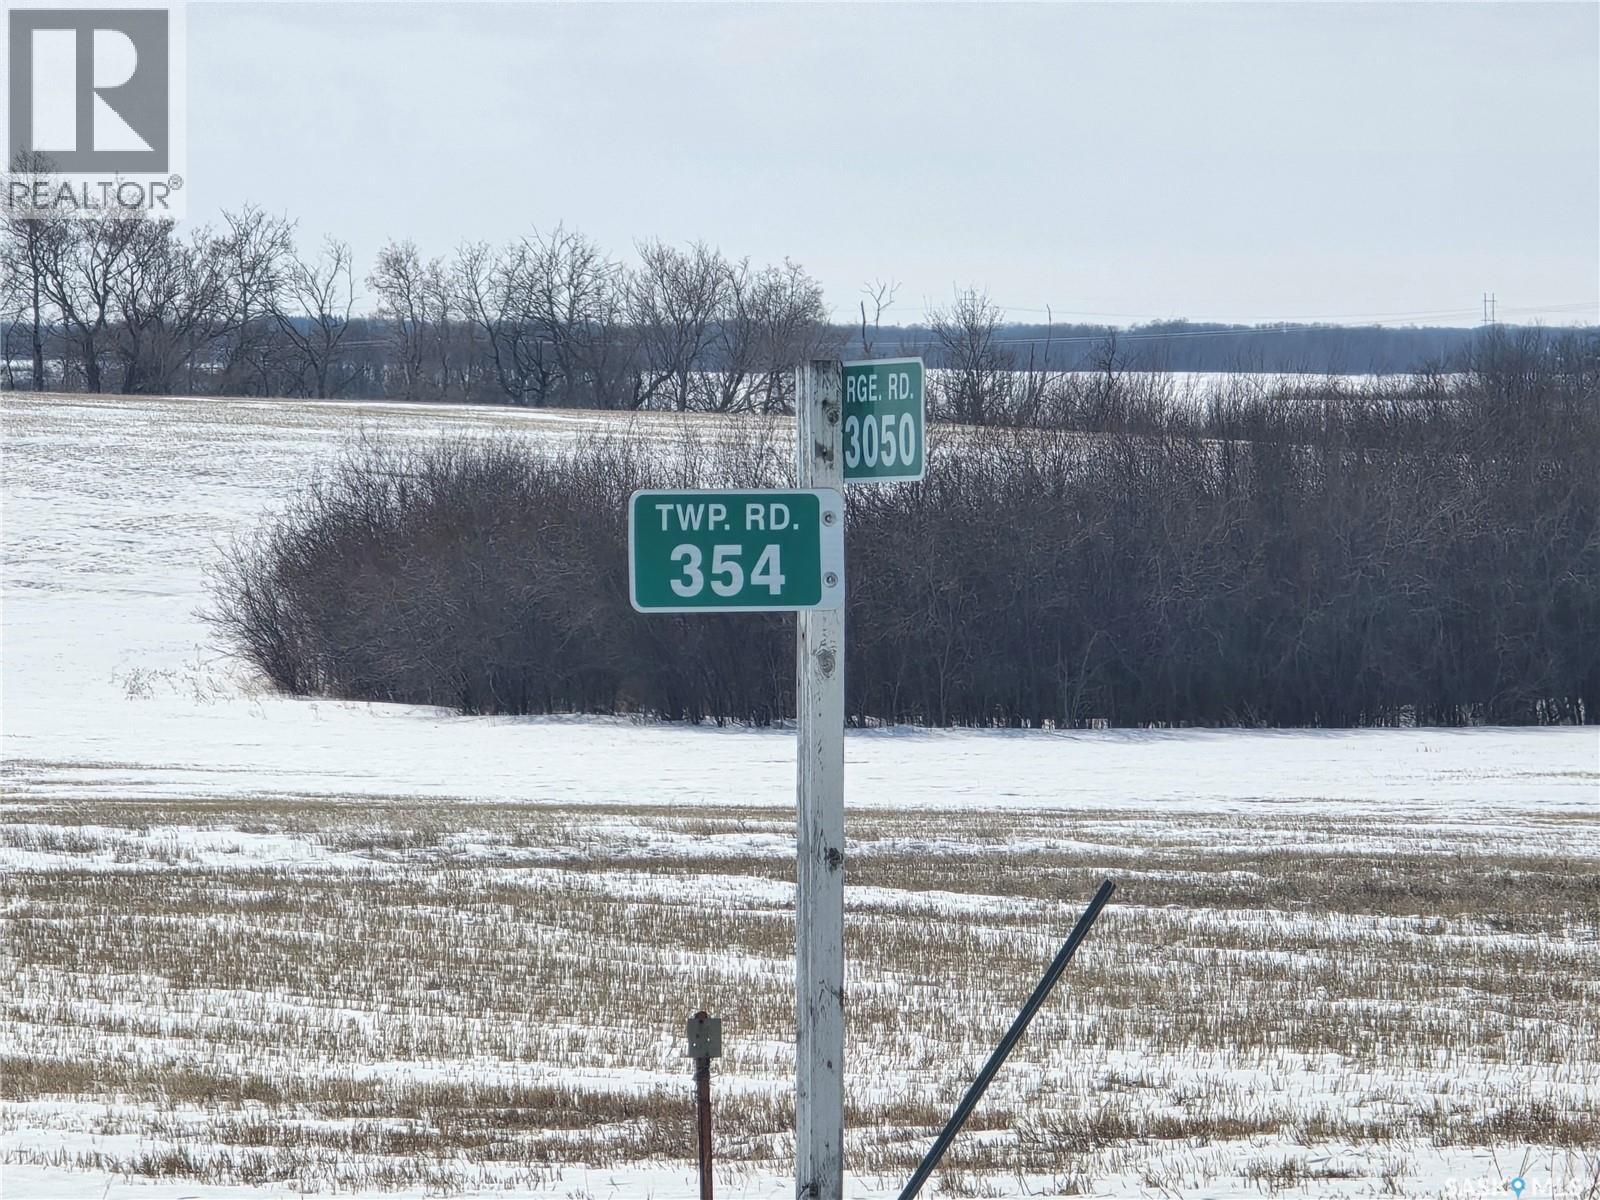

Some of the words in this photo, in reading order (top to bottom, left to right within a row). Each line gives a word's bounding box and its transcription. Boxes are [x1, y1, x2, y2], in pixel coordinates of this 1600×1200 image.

[847, 375, 881, 402] RGE.
[889, 373, 913, 400] RD.
[846, 413, 915, 468] 3050
[655, 504, 730, 531] TWP.
[745, 504, 799, 530] RD.
[670, 544, 785, 597] 354
